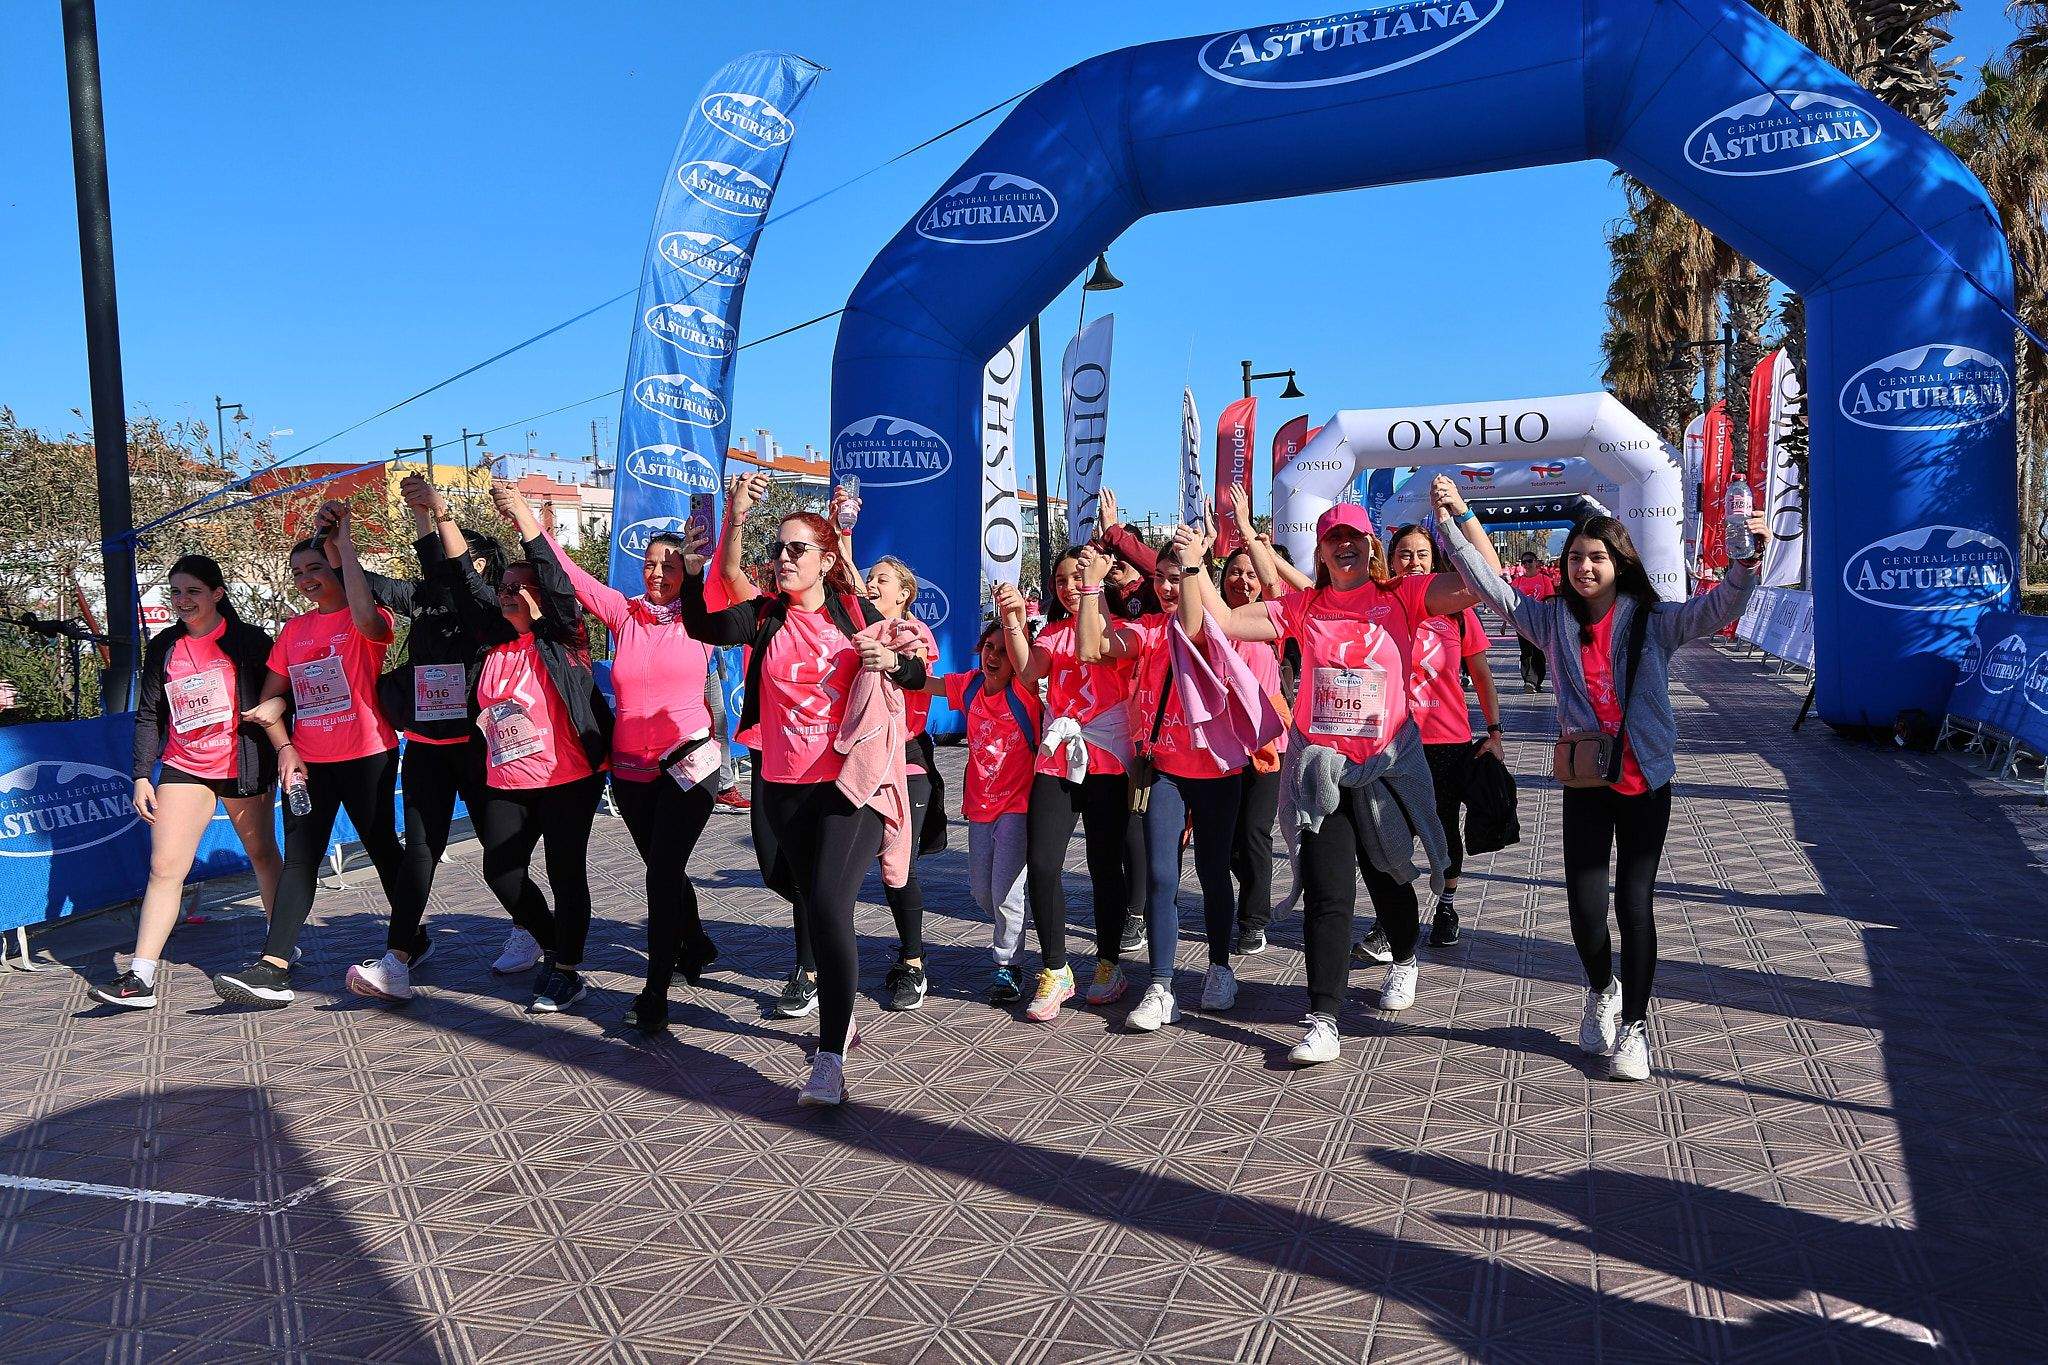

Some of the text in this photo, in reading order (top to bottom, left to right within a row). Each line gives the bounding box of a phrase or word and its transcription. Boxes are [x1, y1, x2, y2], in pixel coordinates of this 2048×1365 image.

[1269, 0, 1440, 33] CENTRAL LECH
[1219, 0, 1479, 69] ASTURIANA
[1728, 117, 1792, 135] CENTRAL
[1700, 120, 1871, 164] ASTURIANA
[945, 193, 1041, 207] CENTRAL LECHERA
[923, 203, 1047, 231] ASTURIANA
[1879, 370, 2001, 386] CENTRAL LECHERA
[640, 384, 720, 422] ASTURIANA
[1851, 382, 2003, 415] ASTURIANA
[1387, 411, 1549, 451] OYSHO
[846, 439, 938, 448] CENTRAL LECHERA
[1598, 439, 1650, 453] OYSHO
[835, 443, 943, 471] ASTURIANA
[985, 343, 1019, 563] OYSHO
[1231, 421, 1245, 485] ntander
[632, 455, 716, 491] ASTURIANA
[1296, 460, 1342, 472] OYSHO
[1486, 504, 1562, 515] VOLVO
[1628, 506, 1677, 519] OYSHO
[1882, 554, 1947, 565] CENTRAL
[1649, 572, 1678, 584] SHO
[1855, 559, 2008, 591] ASTURIANA
[311, 684, 330, 695] 016
[426, 689, 449, 699] 016
[1140, 690, 1154, 704] TU
[189, 695, 209, 709] 016
[1335, 698, 1362, 710] 016
[498, 726, 518, 740] 016
[1, 781, 125, 810] CENTRAL LECHERA
